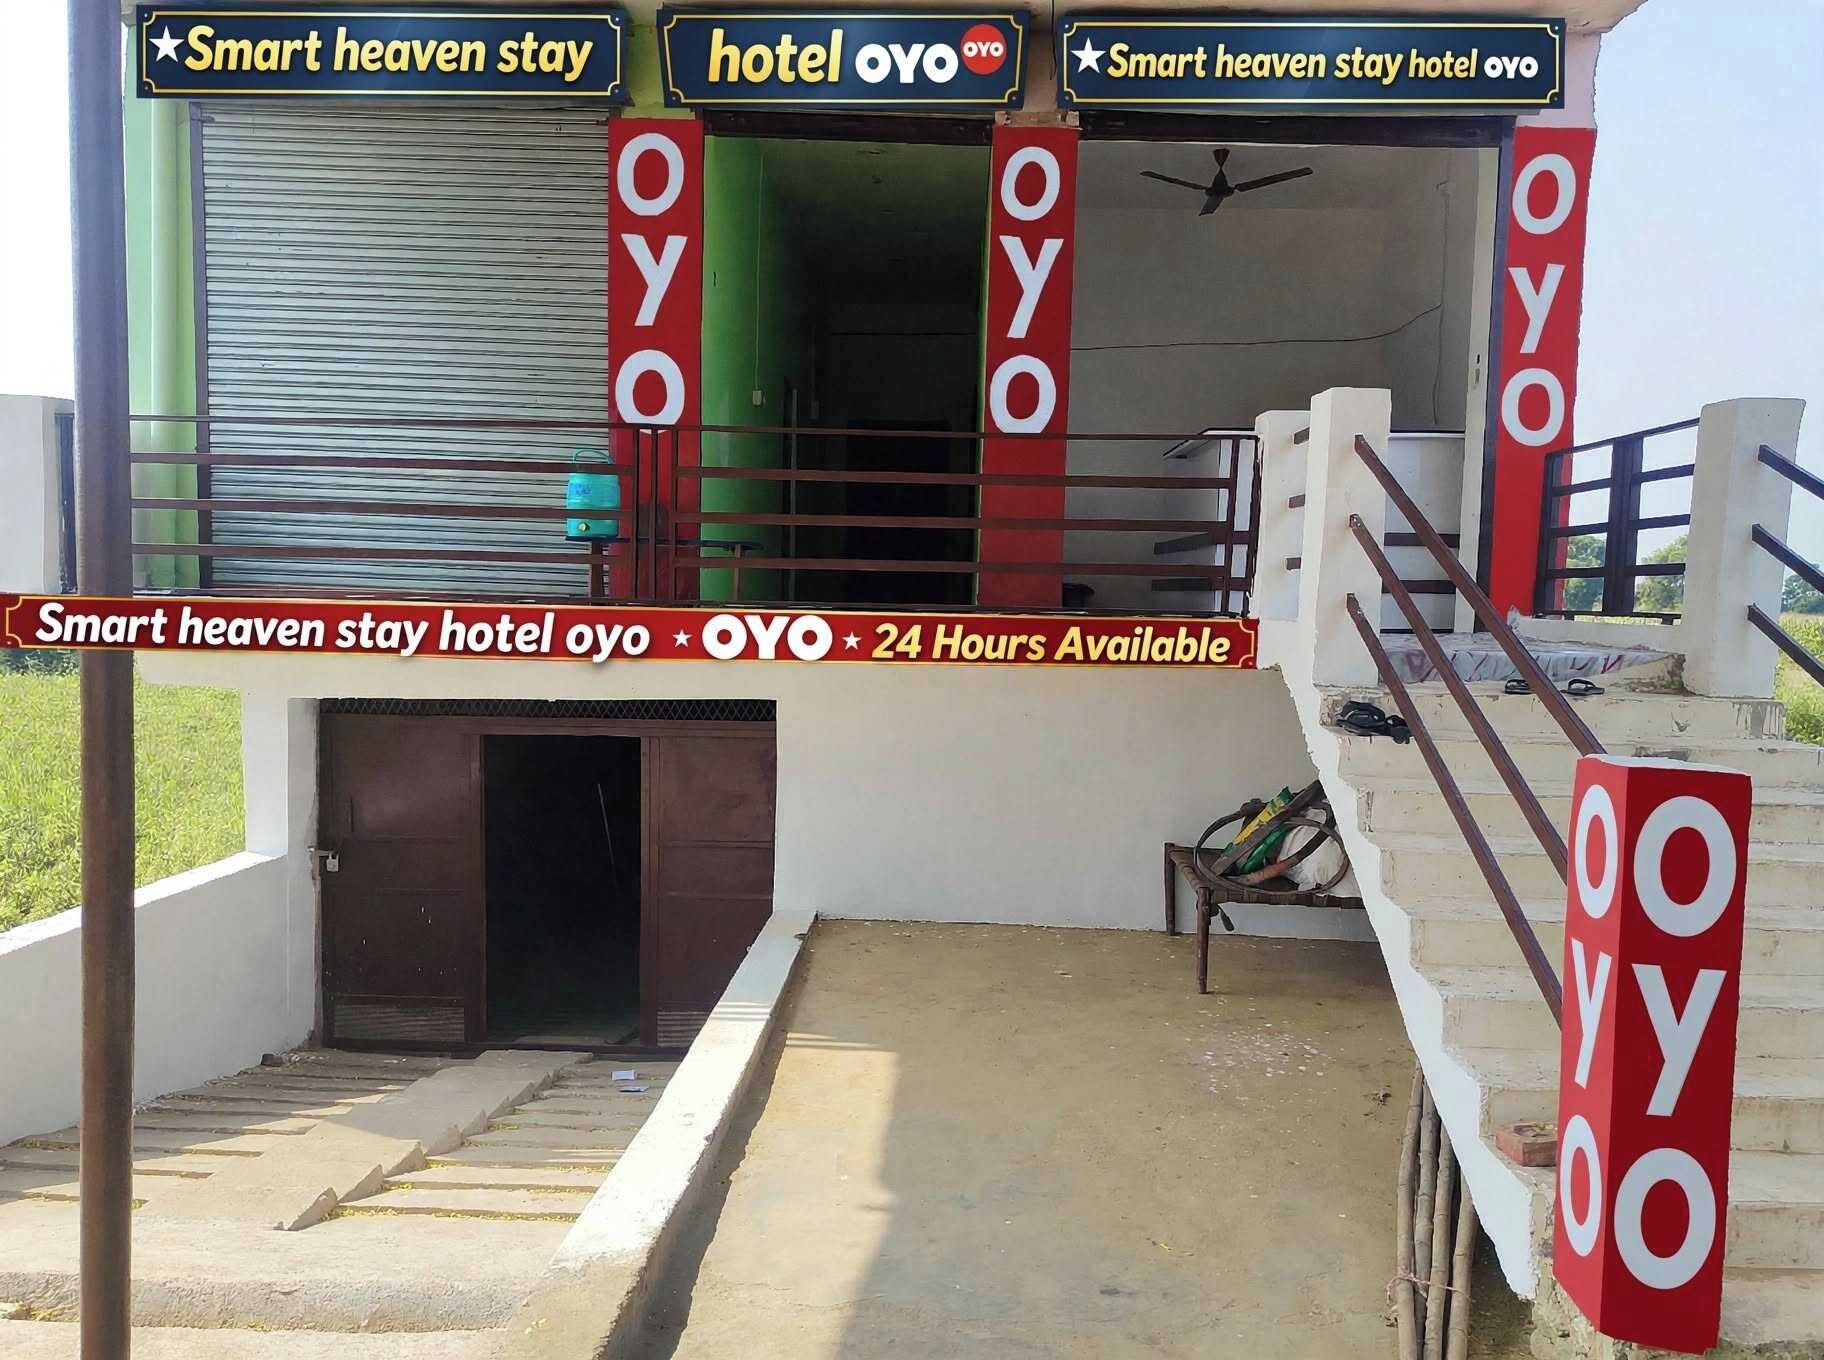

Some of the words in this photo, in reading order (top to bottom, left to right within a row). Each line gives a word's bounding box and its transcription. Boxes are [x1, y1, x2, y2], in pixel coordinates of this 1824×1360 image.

[185, 25, 321, 71] Smart
[333, 26, 486, 72] heaven
[496, 31, 594, 82] stay
[708, 28, 844, 83] hotel
[1107, 42, 1207, 78] Smart
[1214, 43, 1326, 78] heaven
[1334, 46, 1404, 85] stay
[1408, 48, 1478, 79] hotel
[35, 602, 168, 646] Smart
[177, 604, 323, 648] heaven
[335, 613, 430, 658] stay
[439, 604, 556, 654] hotel
[566, 622, 650, 664] oyo
[871, 622, 923, 660] 24
[932, 623, 1046, 662] Hours
[1053, 625, 1232, 665] Available
